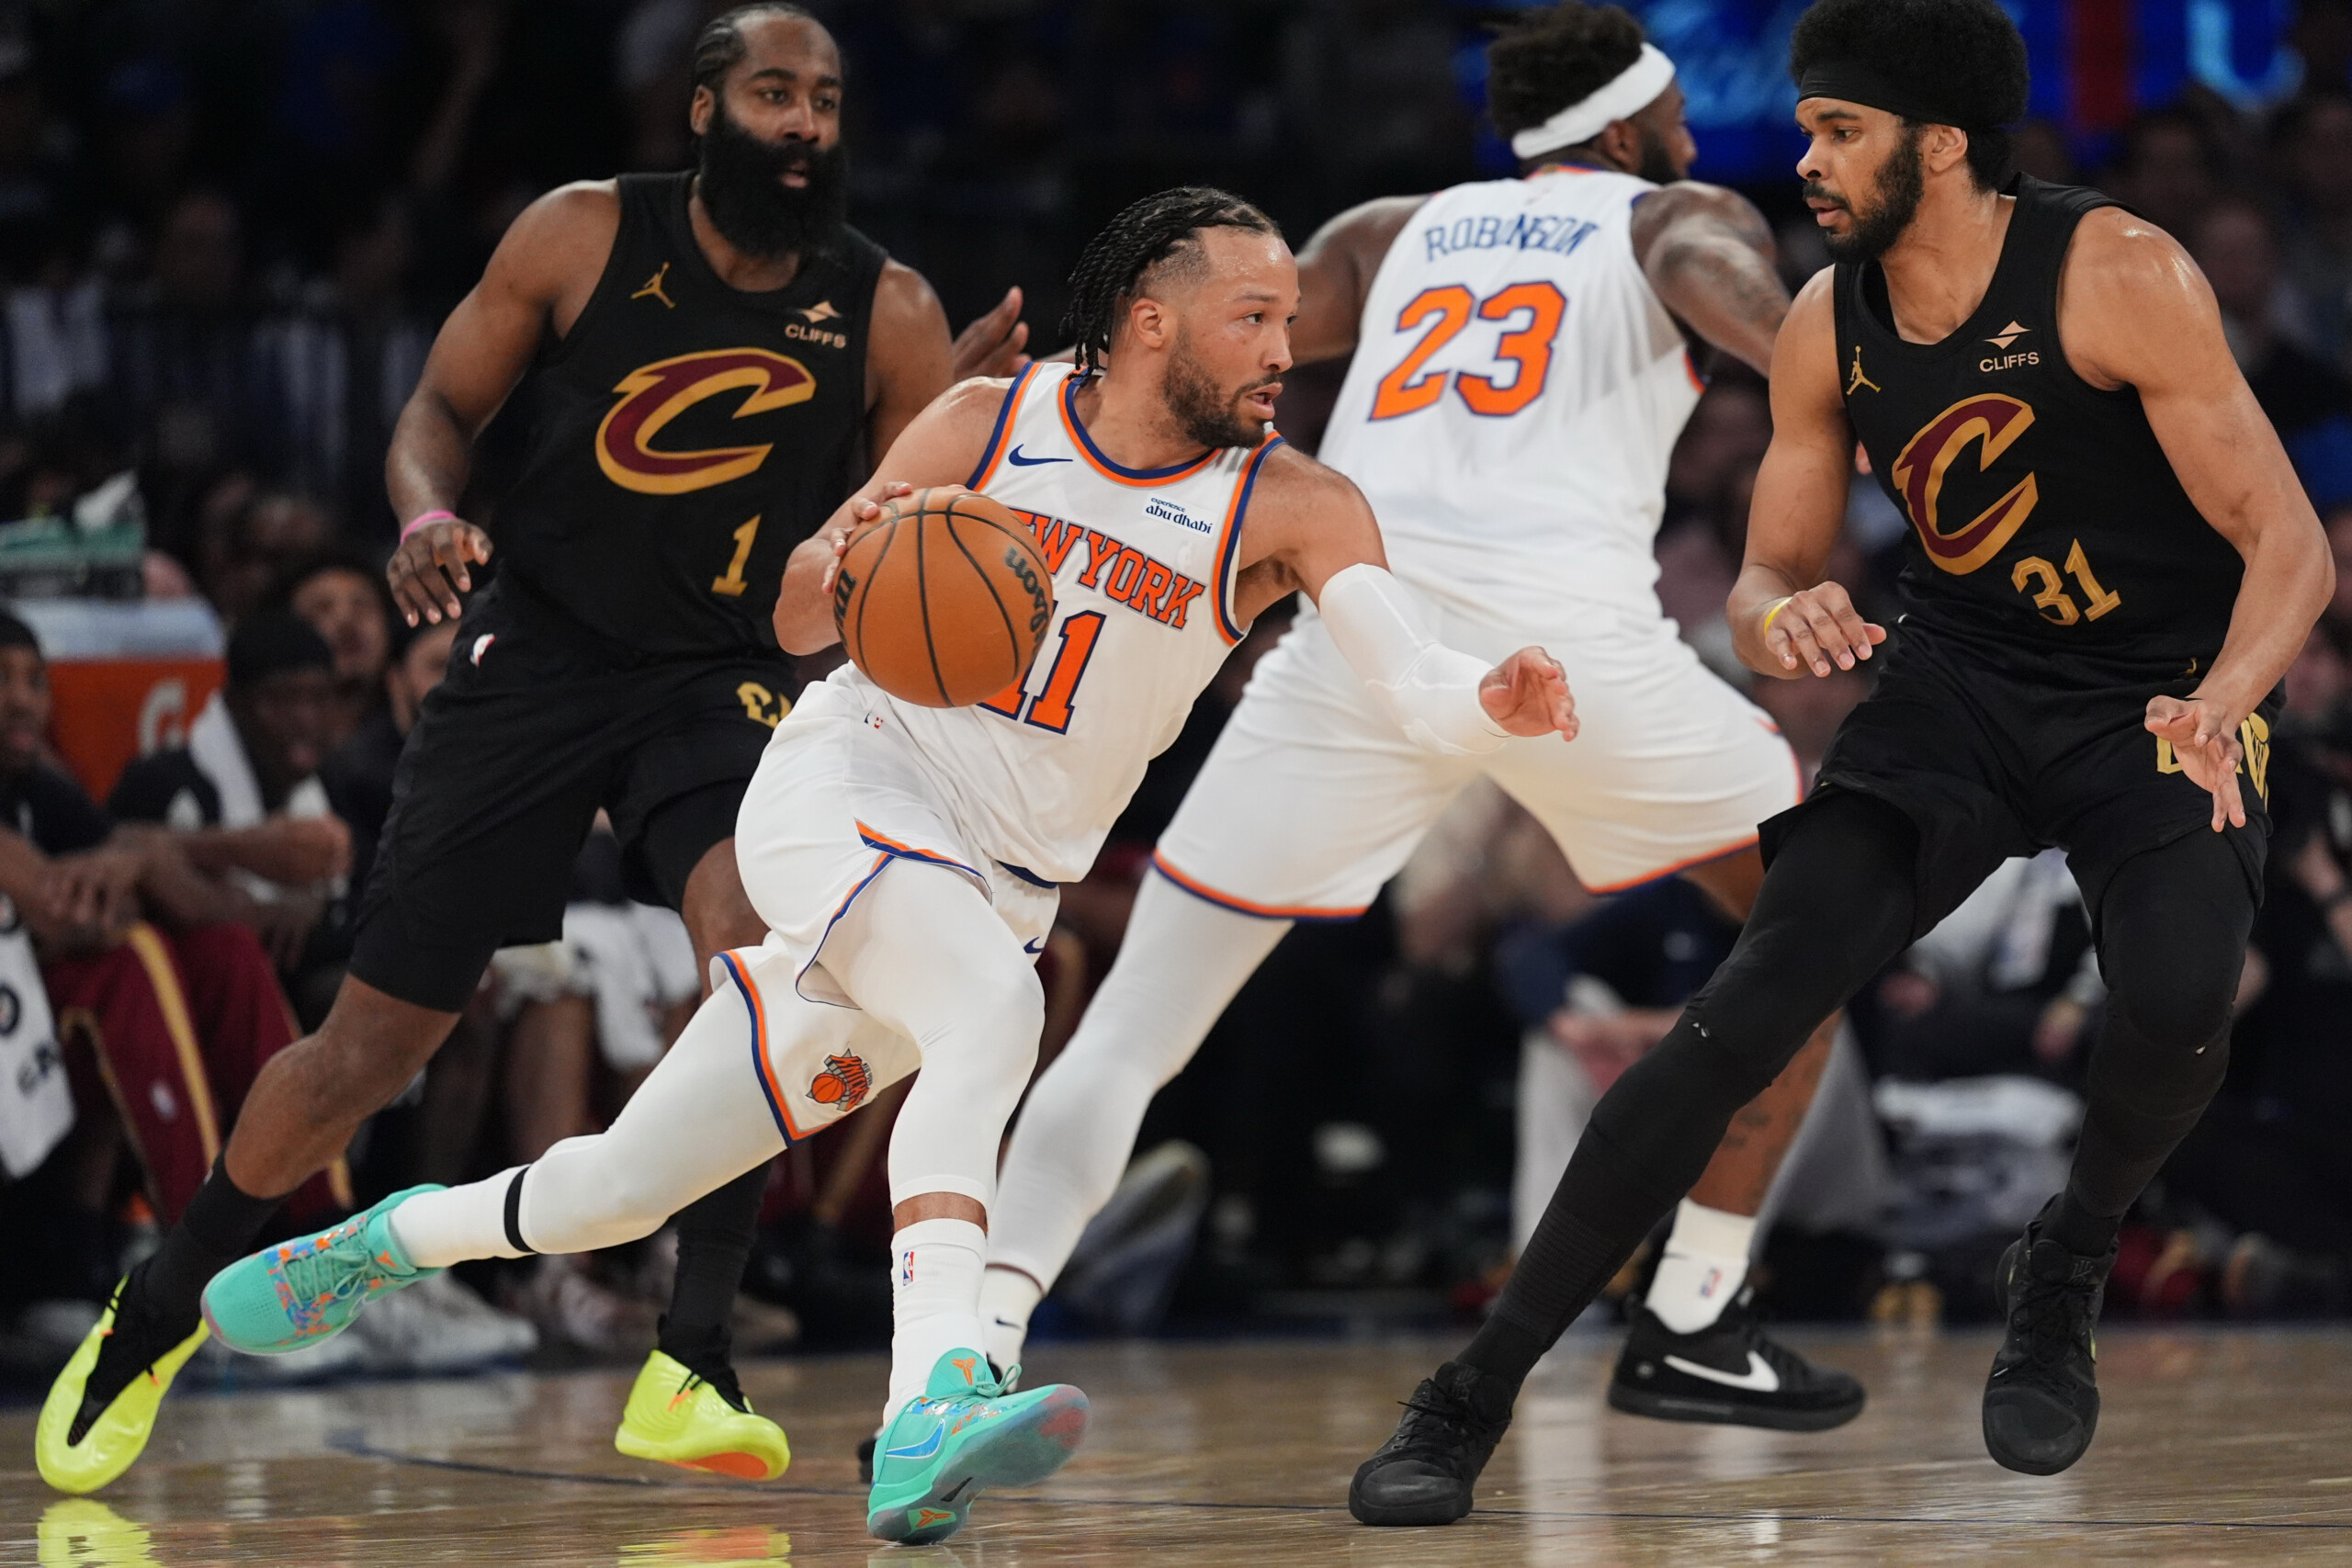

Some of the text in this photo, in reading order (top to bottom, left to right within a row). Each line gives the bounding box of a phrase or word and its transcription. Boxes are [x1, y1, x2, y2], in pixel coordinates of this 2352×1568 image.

[785, 323, 846, 348] CLIFFS
[1367, 280, 1567, 423] 23
[1979, 352, 2040, 372] CLIFFS
[595, 347, 816, 495] C
[1146, 505, 1213, 534] abu dhabi
[1150, 497, 1185, 513] experience
[1893, 393, 2039, 575] C
[711, 514, 761, 596] 1
[1078, 529, 1206, 631] YORK
[2011, 538, 2121, 626] 31
[830, 1055, 870, 1111] KNICKS
